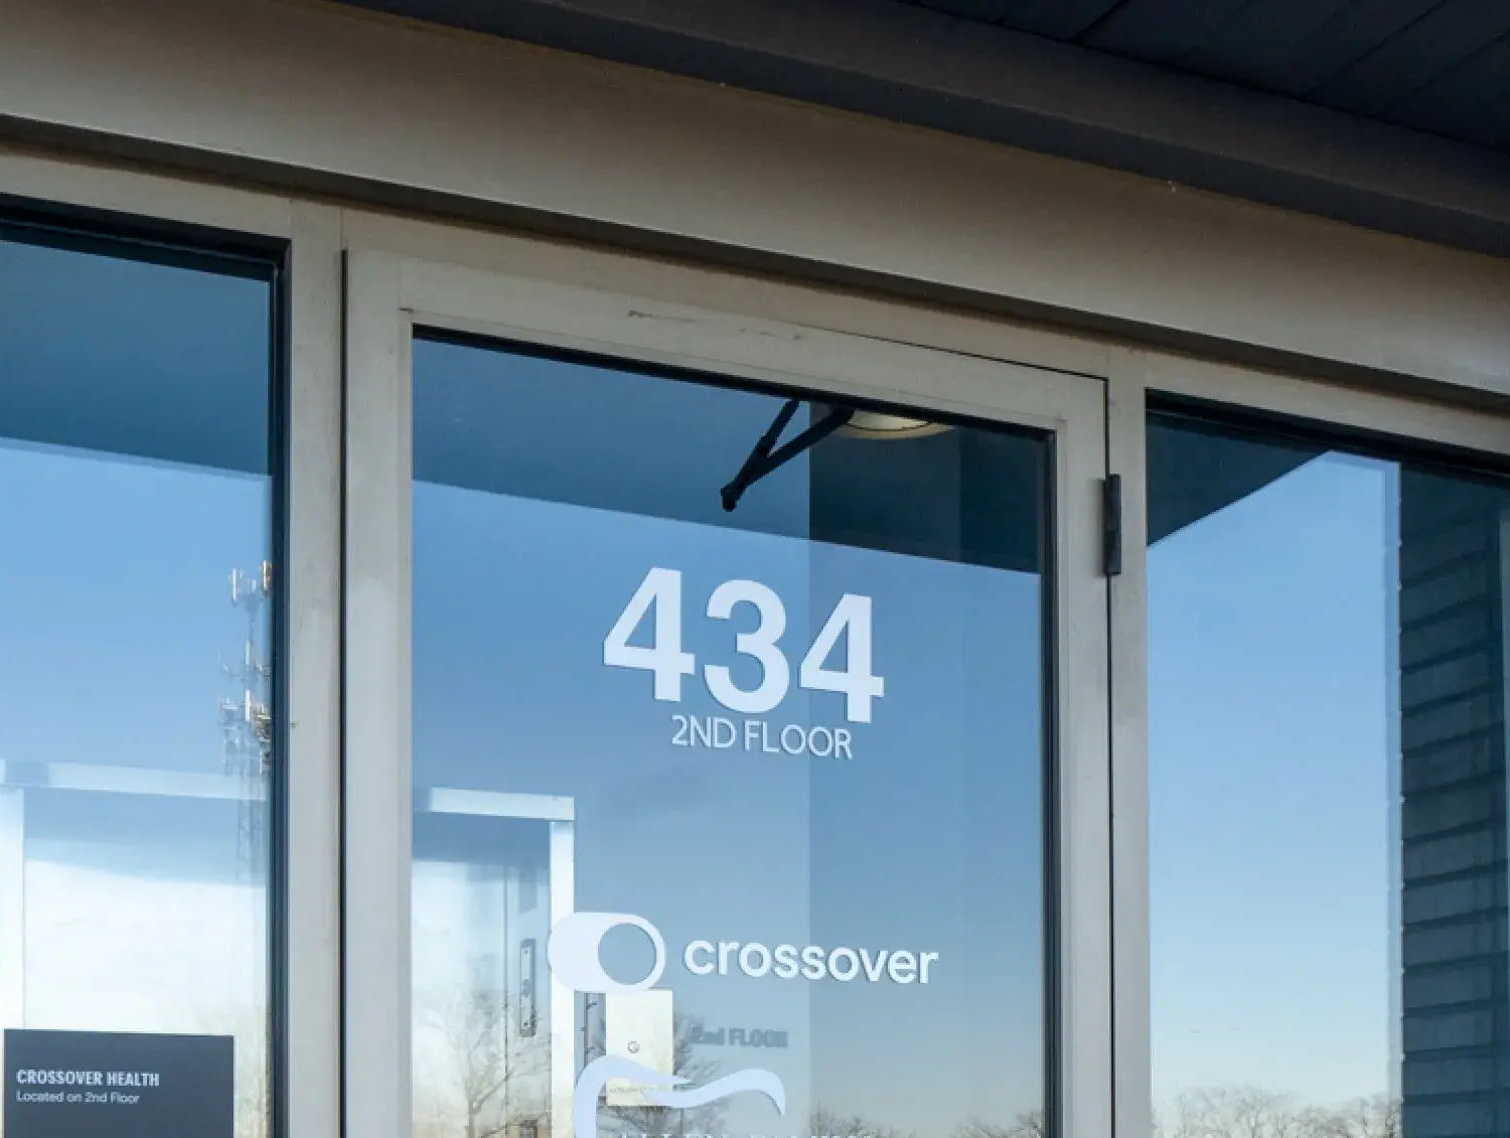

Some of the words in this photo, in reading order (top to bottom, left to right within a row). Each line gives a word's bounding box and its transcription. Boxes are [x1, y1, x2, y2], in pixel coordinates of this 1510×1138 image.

[602, 566, 885, 724] 434
[671, 713, 737, 751] 2ND
[744, 720, 853, 759] FLOOR
[684, 939, 939, 984] crossover
[16, 1069, 103, 1086] CROSSOVER
[106, 1072, 160, 1087] HEALTH
[16, 1090, 64, 1103] Located
[67, 1093, 83, 1103] on
[84, 1091, 108, 1104] 2nd
[110, 1092, 140, 1105] Floor
